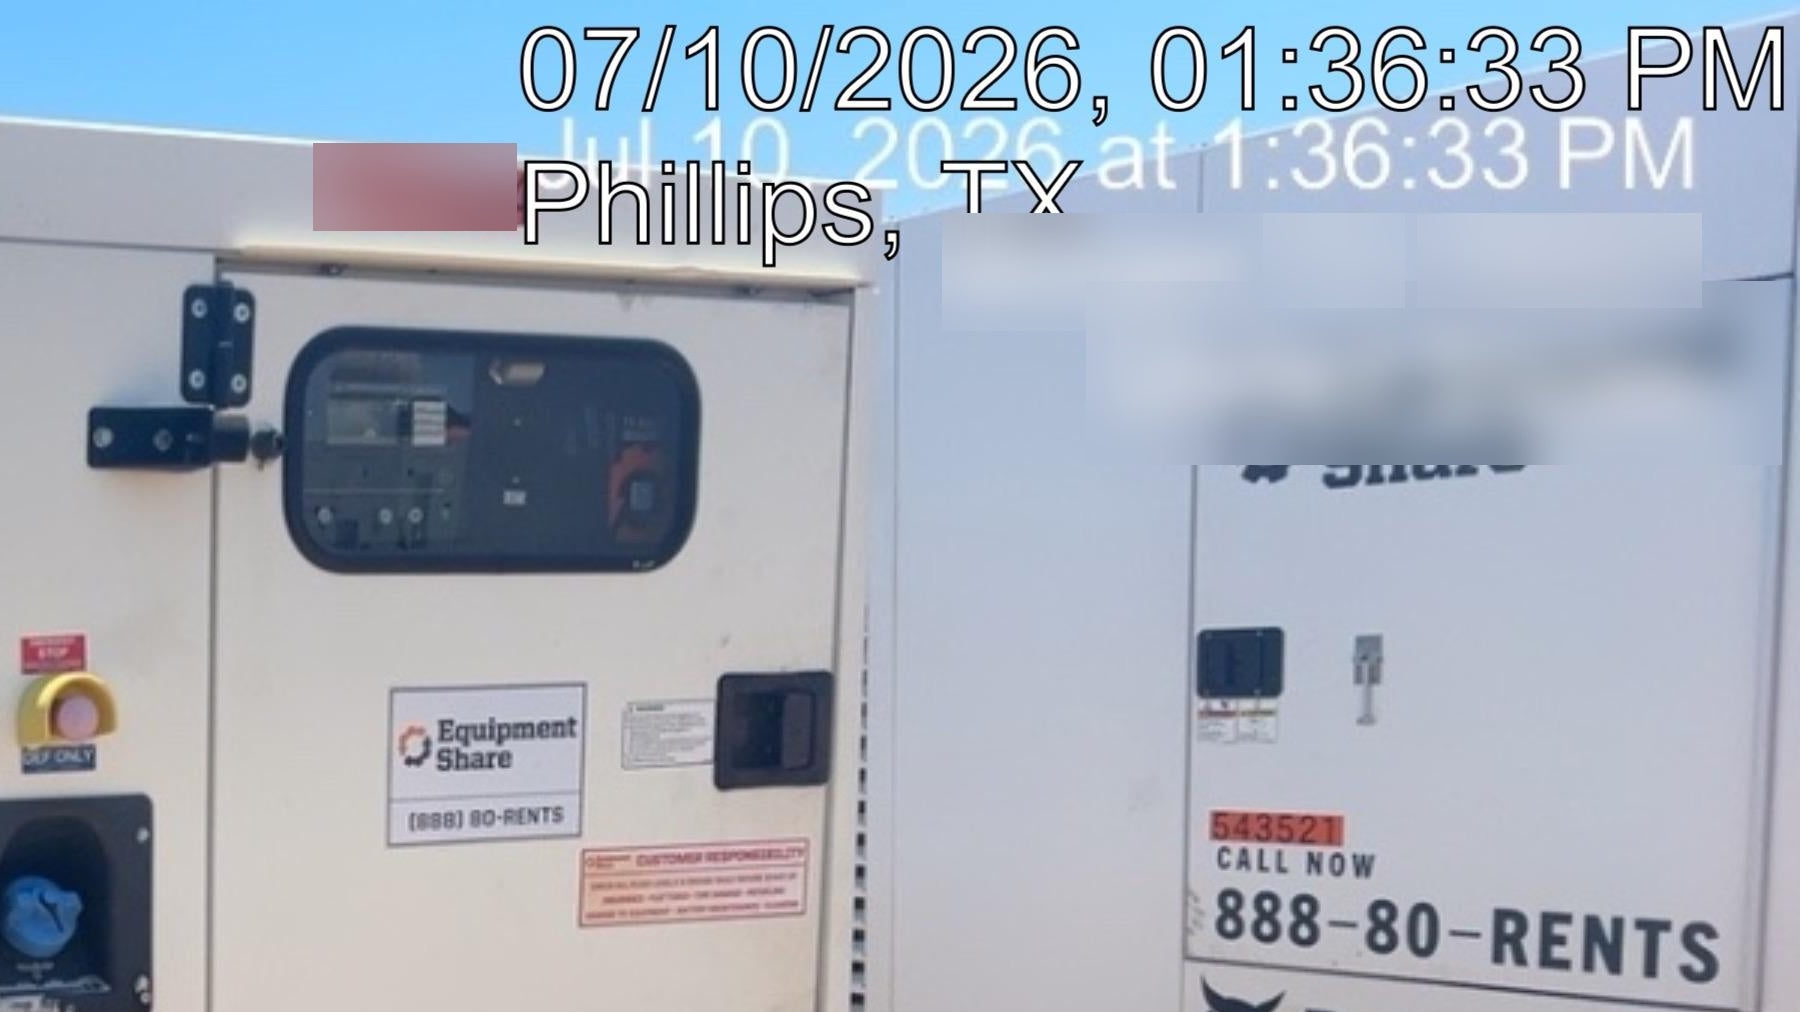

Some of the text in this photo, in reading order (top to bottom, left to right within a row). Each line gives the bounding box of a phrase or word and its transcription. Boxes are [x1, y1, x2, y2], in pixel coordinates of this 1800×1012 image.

[437, 717, 577, 746] Equipment
[436, 747, 513, 771] Share
[469, 806, 565, 829] 80-RENTS
[1211, 812, 1337, 845] 543521
[1216, 846, 1376, 879] CALL NOW
[1215, 887, 1720, 984] 888-80-RENTS
